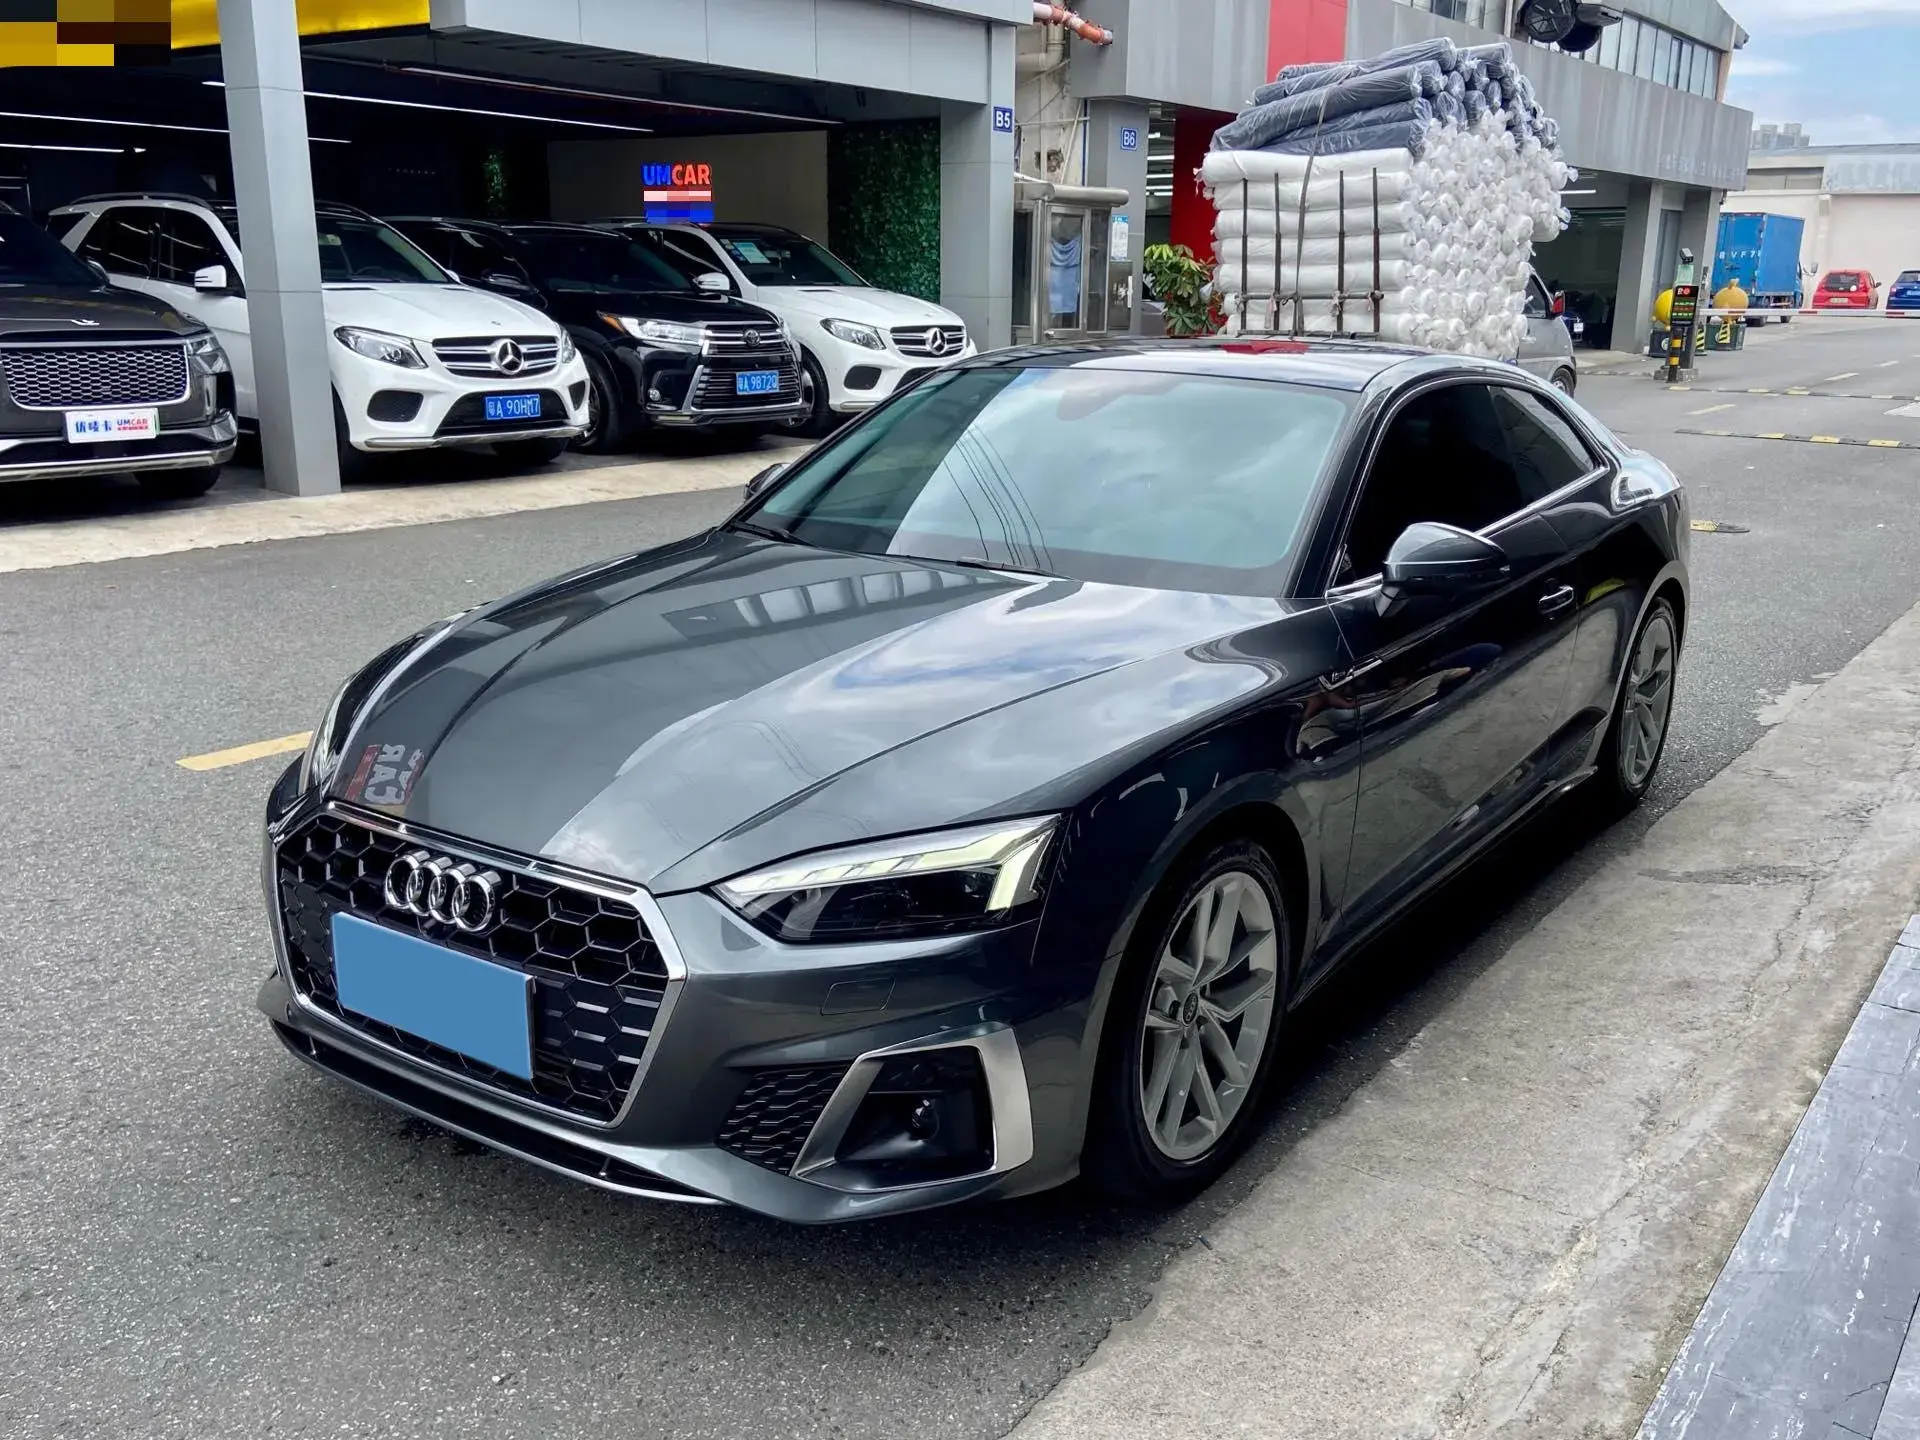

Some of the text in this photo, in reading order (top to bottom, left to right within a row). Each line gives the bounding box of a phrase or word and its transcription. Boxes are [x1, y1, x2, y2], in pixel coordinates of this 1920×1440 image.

[996, 110, 1010, 128] B5
[1124, 131, 1135, 146] B6
[643, 164, 710, 186] UMCAR
